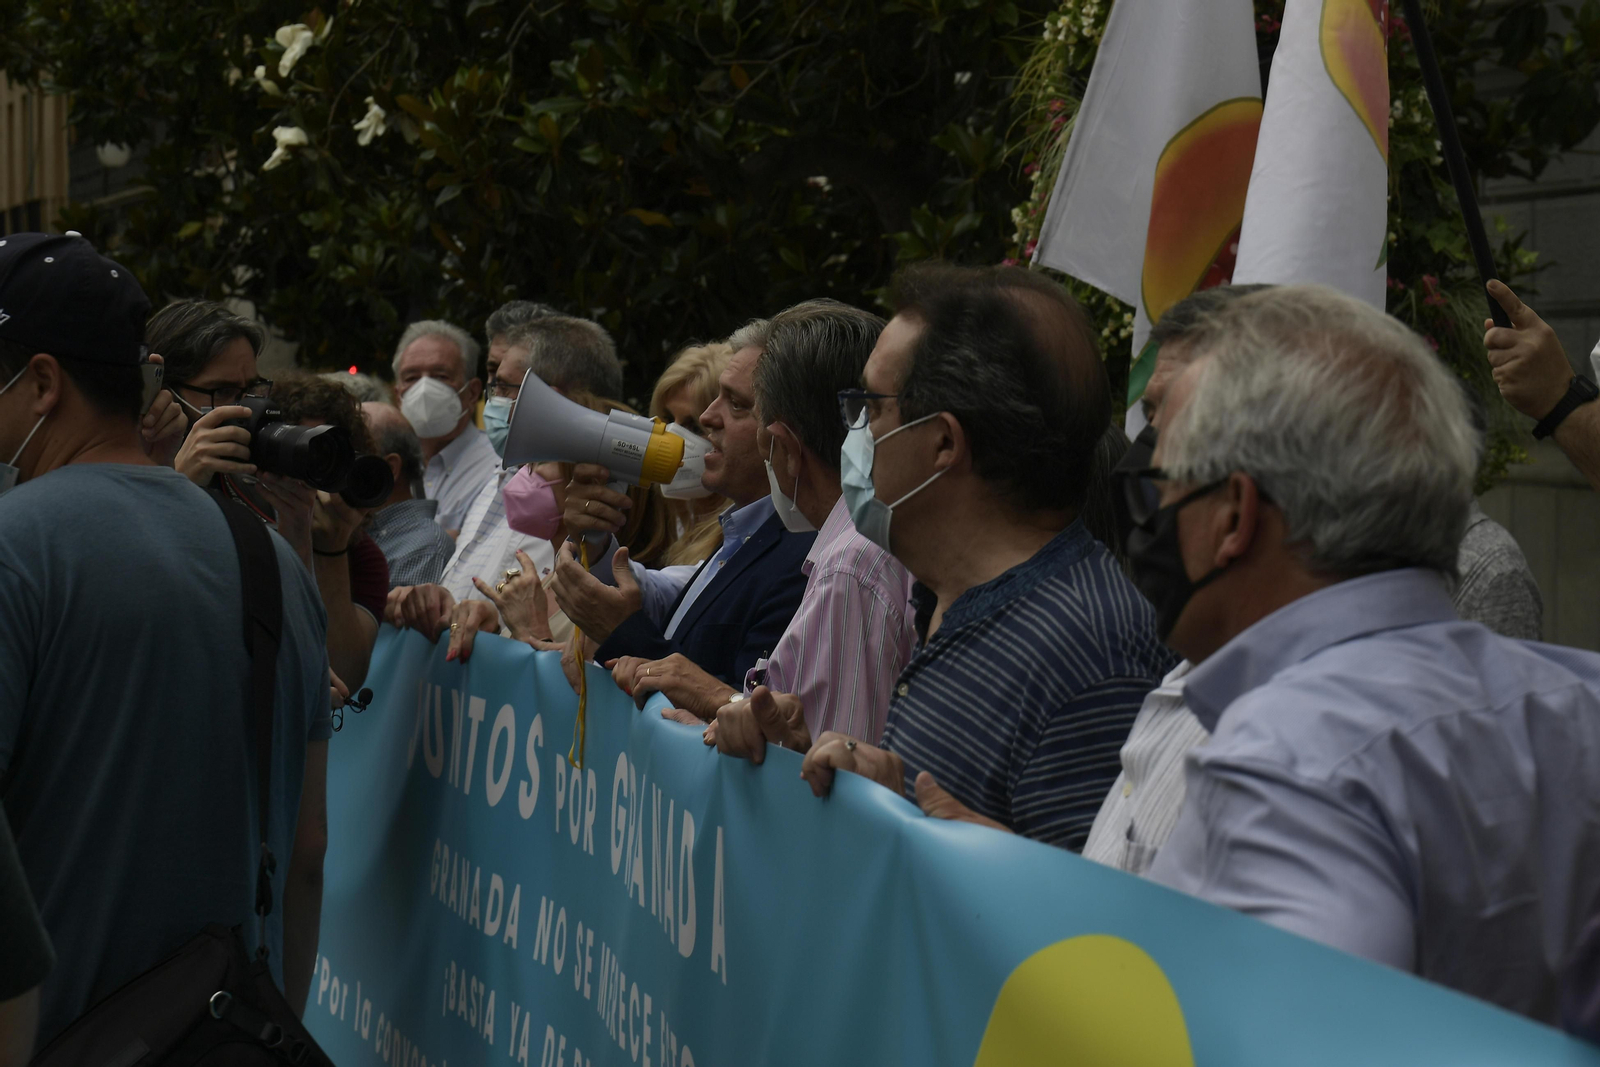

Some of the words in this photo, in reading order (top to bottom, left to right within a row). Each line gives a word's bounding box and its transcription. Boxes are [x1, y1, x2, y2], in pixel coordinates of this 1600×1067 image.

[407, 678, 544, 820] JUNTOS
[555, 753, 597, 856] POR
[610, 751, 727, 986] GRANADA
[354, 980, 372, 1040] la
[430, 838, 522, 950] GRANADA
[533, 895, 567, 975] NO
[574, 920, 595, 1000] SE
[597, 941, 653, 1067] MERECE
[660, 1010, 696, 1067] EST
[442, 960, 496, 1046] ¡BASTA
[509, 1001, 531, 1067] YA
